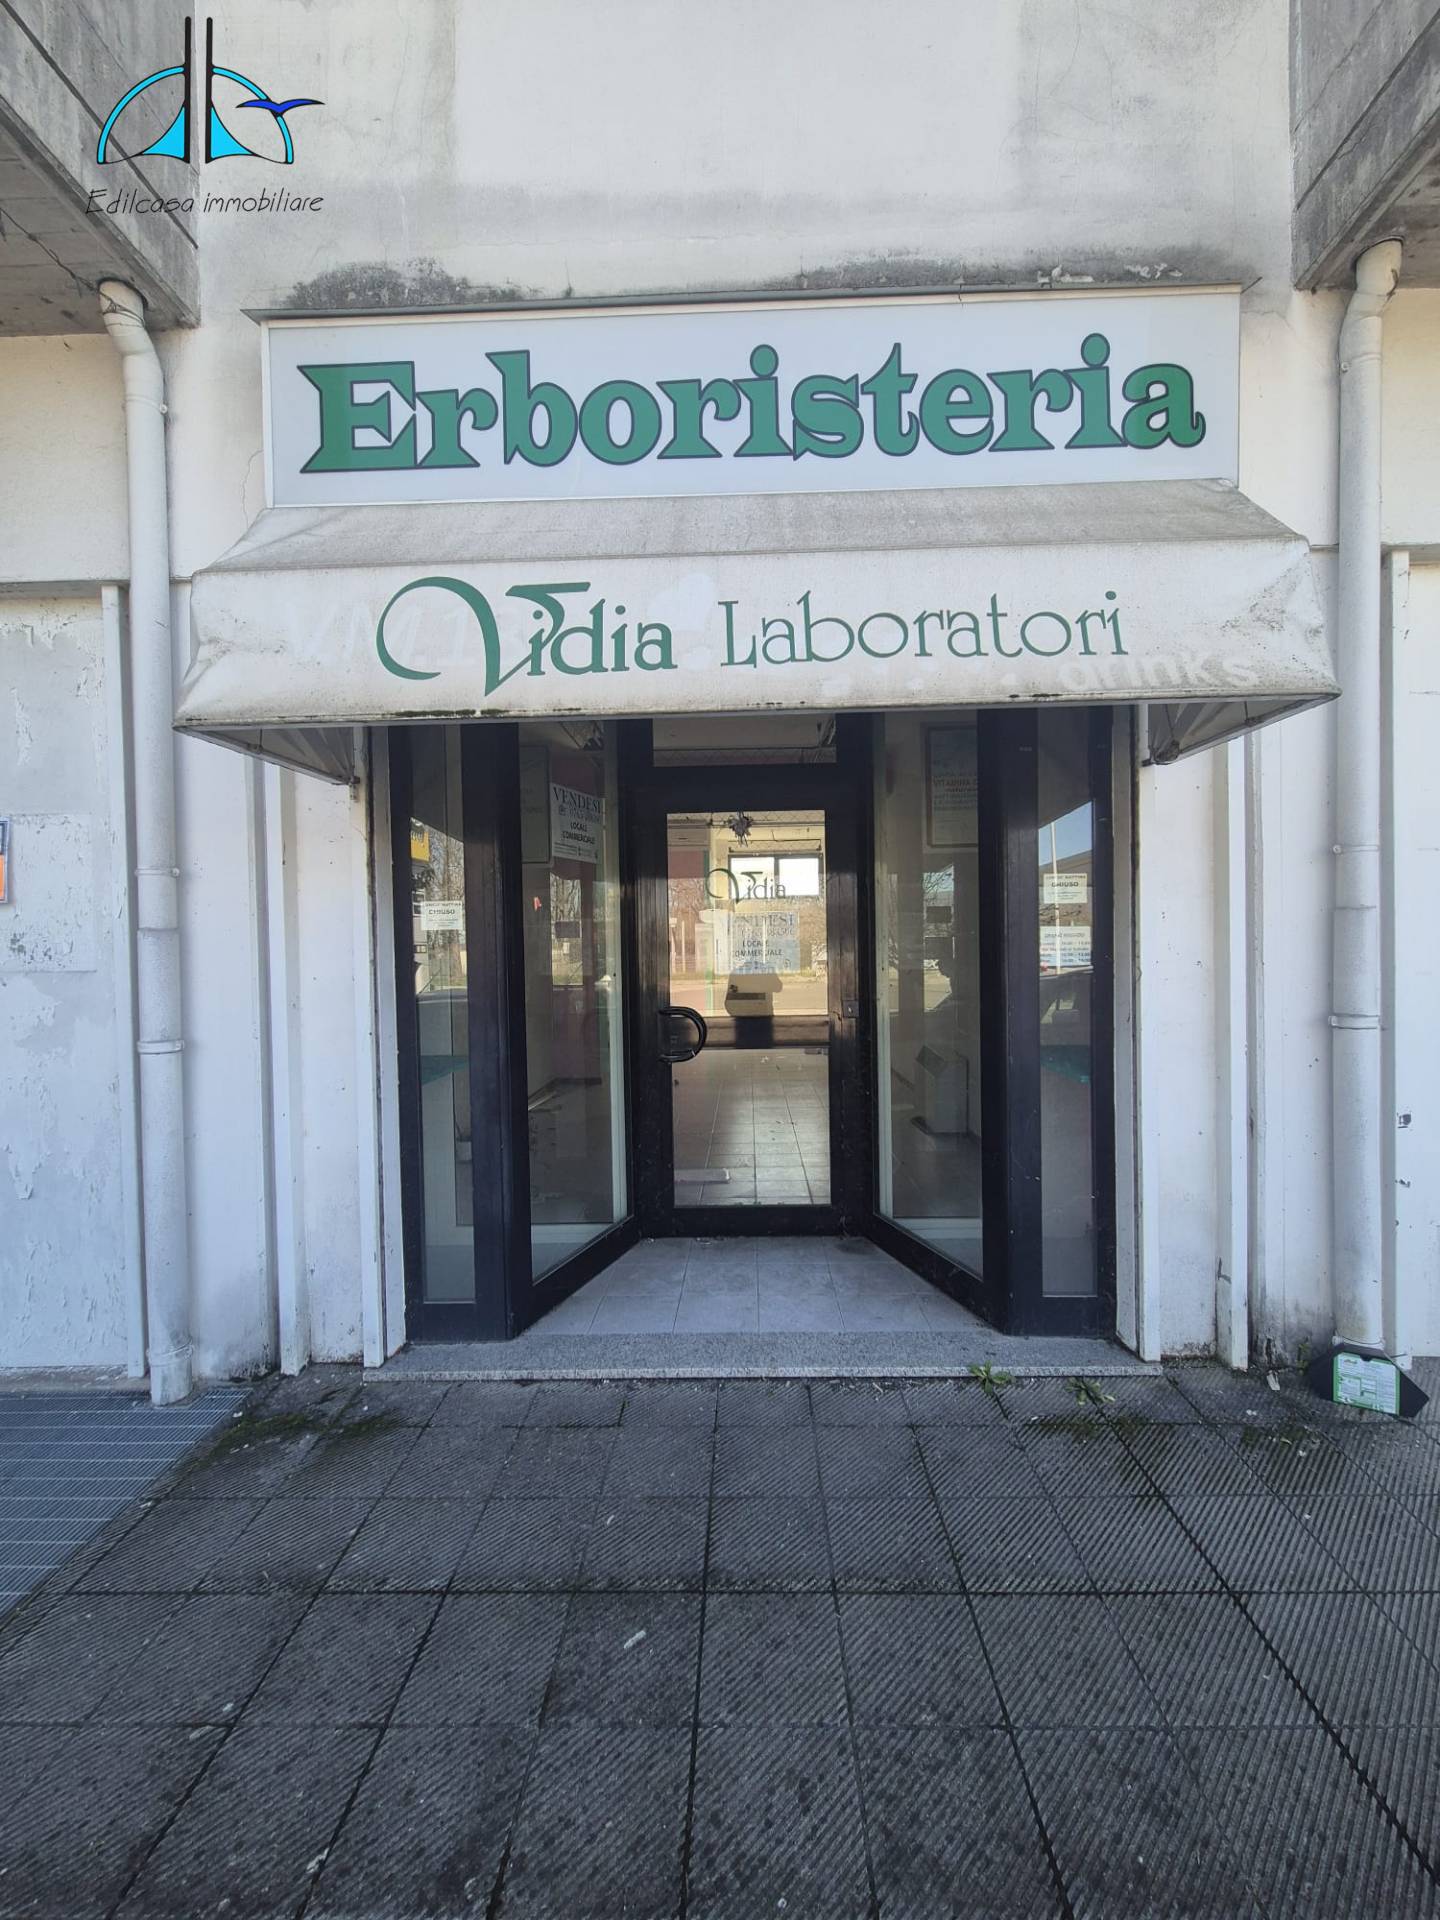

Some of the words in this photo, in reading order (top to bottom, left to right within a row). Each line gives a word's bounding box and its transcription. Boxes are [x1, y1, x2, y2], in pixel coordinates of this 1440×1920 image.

[297, 332, 1206, 474] Erboristeria
[376, 576, 676, 697] Vidia
[719, 591, 1129, 668] Laboratori
[553, 786, 601, 814] VENDESI
[705, 868, 786, 904] Vidia
